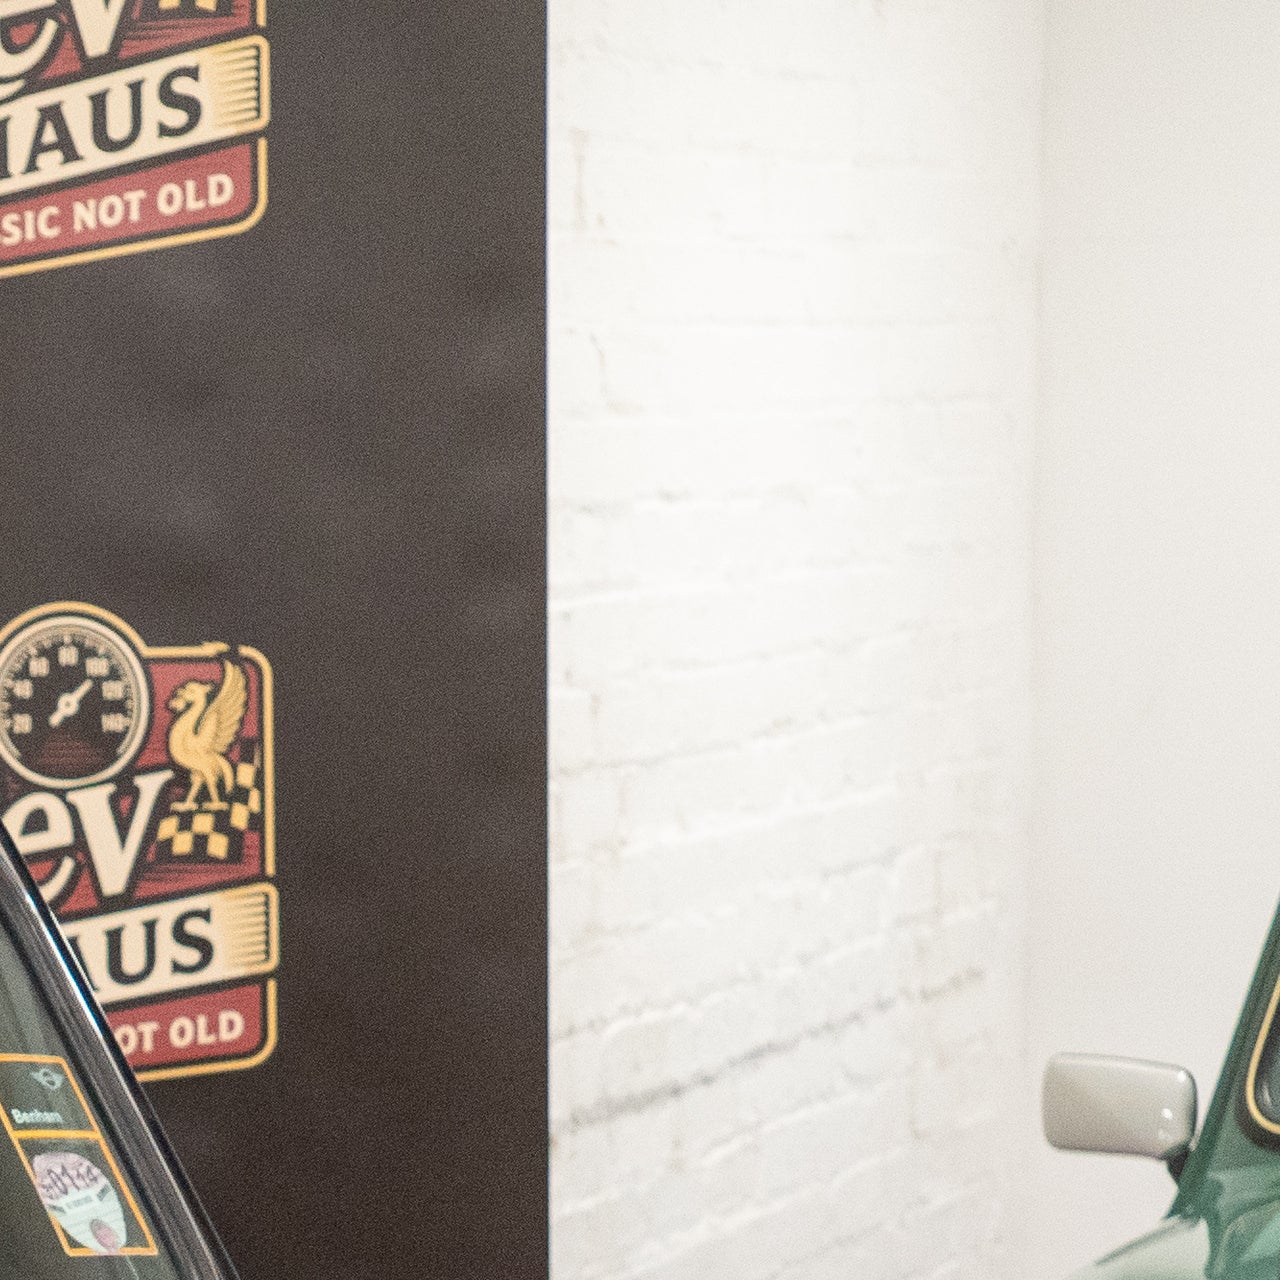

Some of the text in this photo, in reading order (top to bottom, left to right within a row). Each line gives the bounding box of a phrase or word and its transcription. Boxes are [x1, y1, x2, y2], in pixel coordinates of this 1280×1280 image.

[73, 190, 148, 233] NOT
[157, 173, 235, 217] OLD
[119, 1010, 244, 1056] OT OLD
